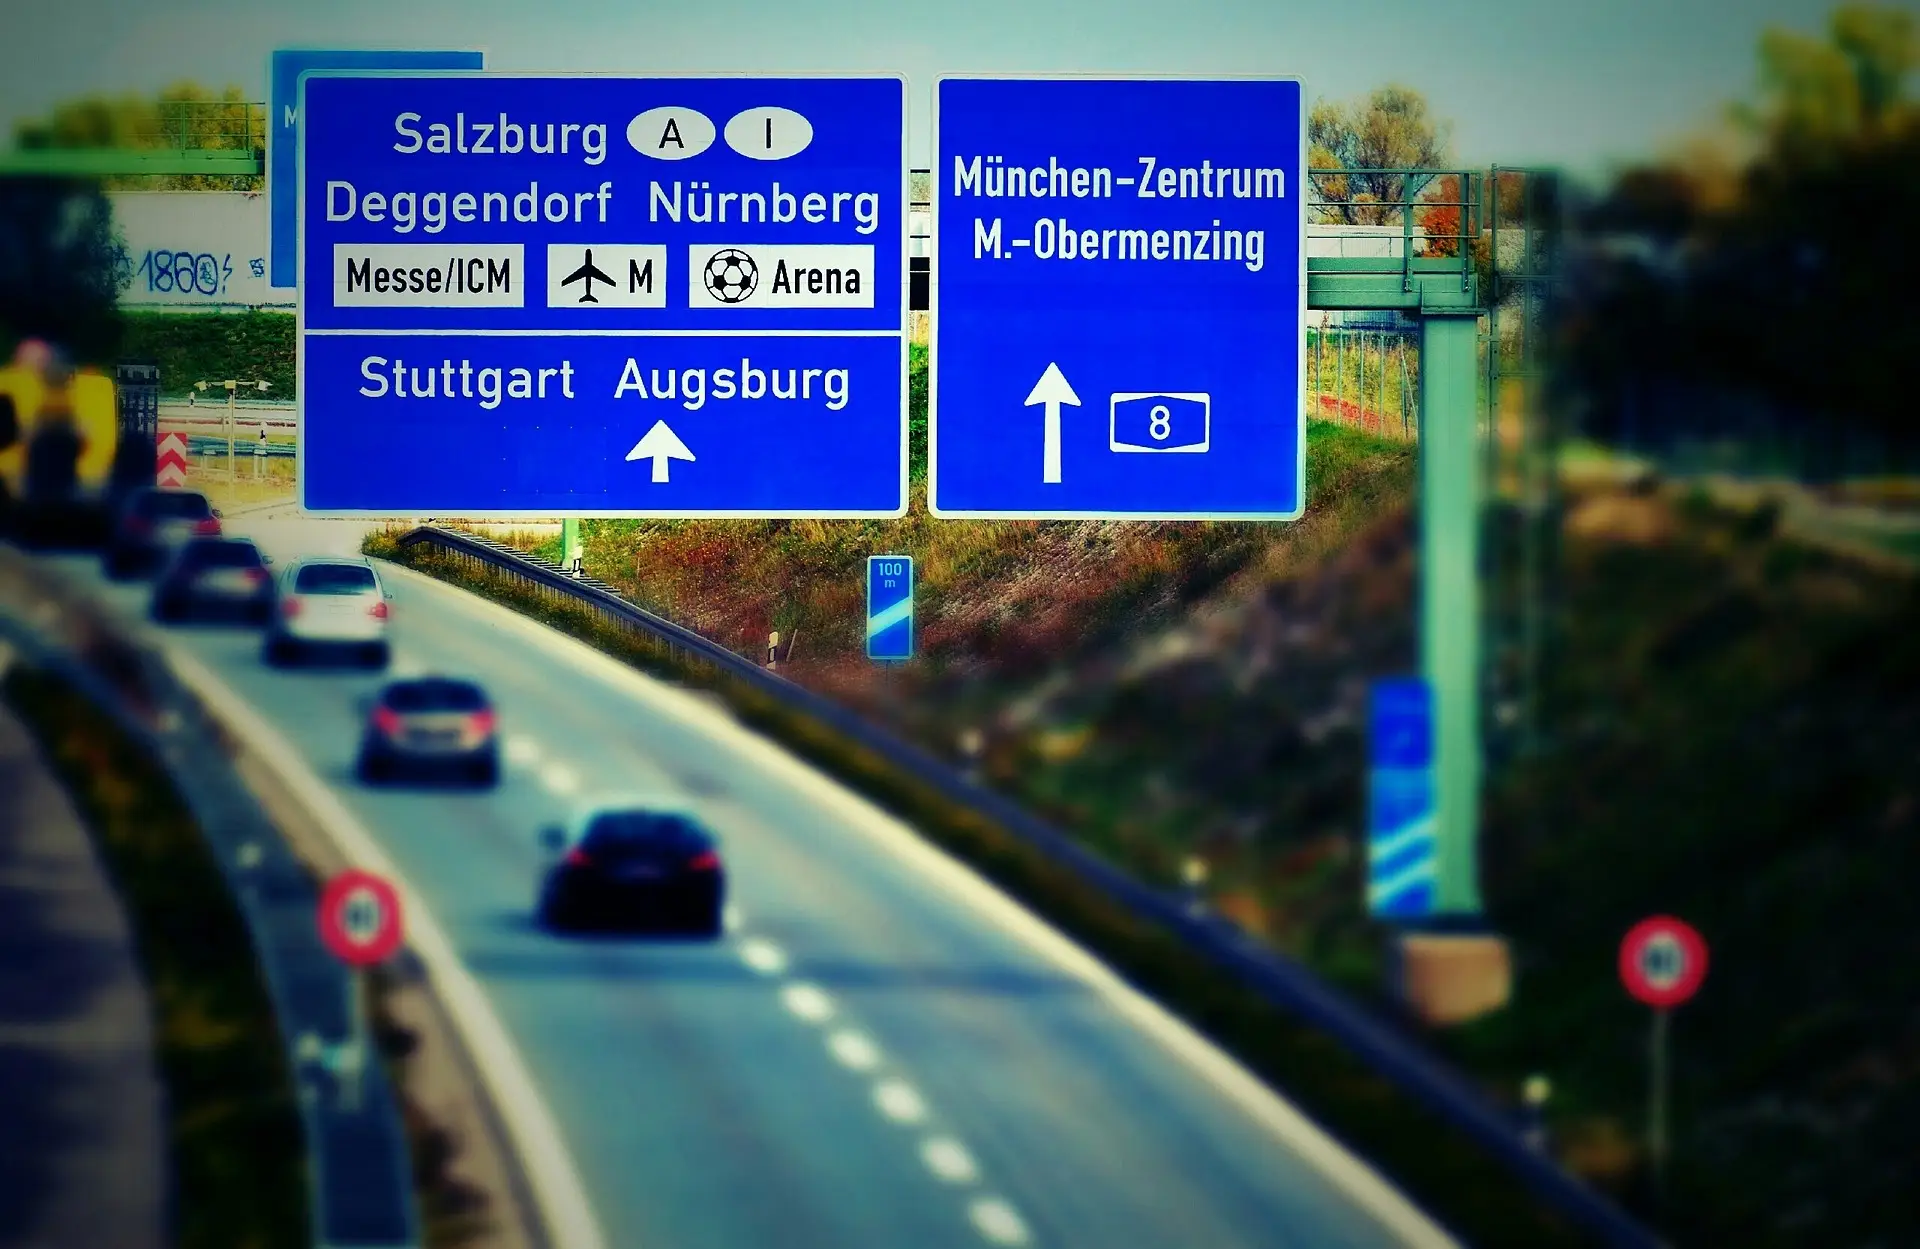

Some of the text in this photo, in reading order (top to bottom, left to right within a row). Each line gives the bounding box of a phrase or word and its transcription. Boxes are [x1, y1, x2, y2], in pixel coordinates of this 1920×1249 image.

[393, 112, 607, 166] Salzburg
[658, 118, 685, 149] A
[954, 155, 1285, 199] München-Zentrum
[326, 180, 879, 235] Deggendorf Nürnberg
[974, 217, 1265, 272] M.-Obermenzing
[347, 257, 510, 294] Messe/ICM
[629, 259, 653, 294] M
[771, 259, 861, 294] Arena
[359, 355, 849, 411] Stuttgart Augsburg
[1149, 405, 1171, 441] 8
[878, 562, 902, 576] 100
[884, 579, 896, 588] m
